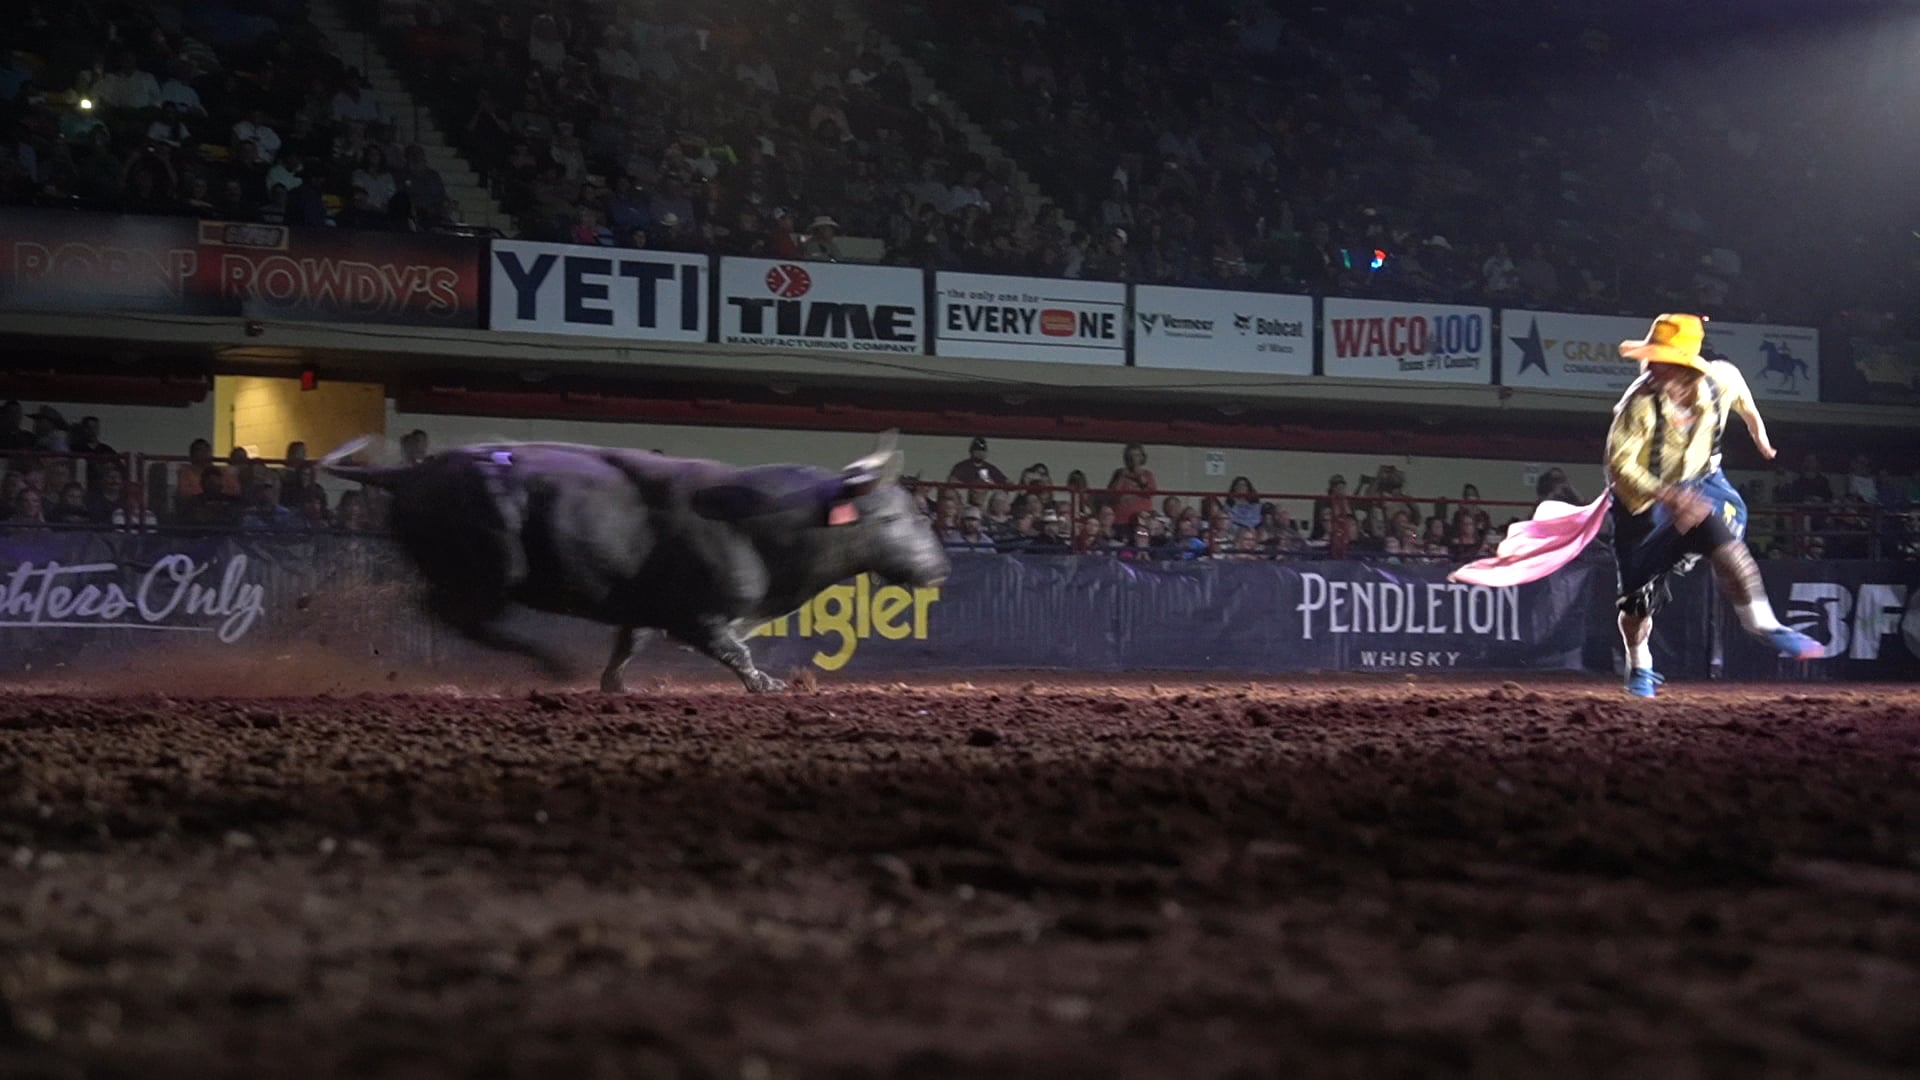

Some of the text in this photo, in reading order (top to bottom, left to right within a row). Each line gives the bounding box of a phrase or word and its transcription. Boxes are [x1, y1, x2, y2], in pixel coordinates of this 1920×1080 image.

[221, 254, 459, 318] ROWDY'S
[494, 251, 698, 331] YETI
[947, 290, 966, 299] the
[970, 291, 995, 303] only
[997, 293, 1018, 302] one
[727, 297, 916, 342] TIME
[1256, 317, 1303, 338] Bobcat
[1331, 314, 1482, 358] WACO 100
[727, 336, 917, 353] MANUFACTURING COMPANY
[0, 553, 265, 643] hters Only
[1295, 572, 1521, 641] PENDLETON
[1360, 650, 1461, 667] WHISKY
